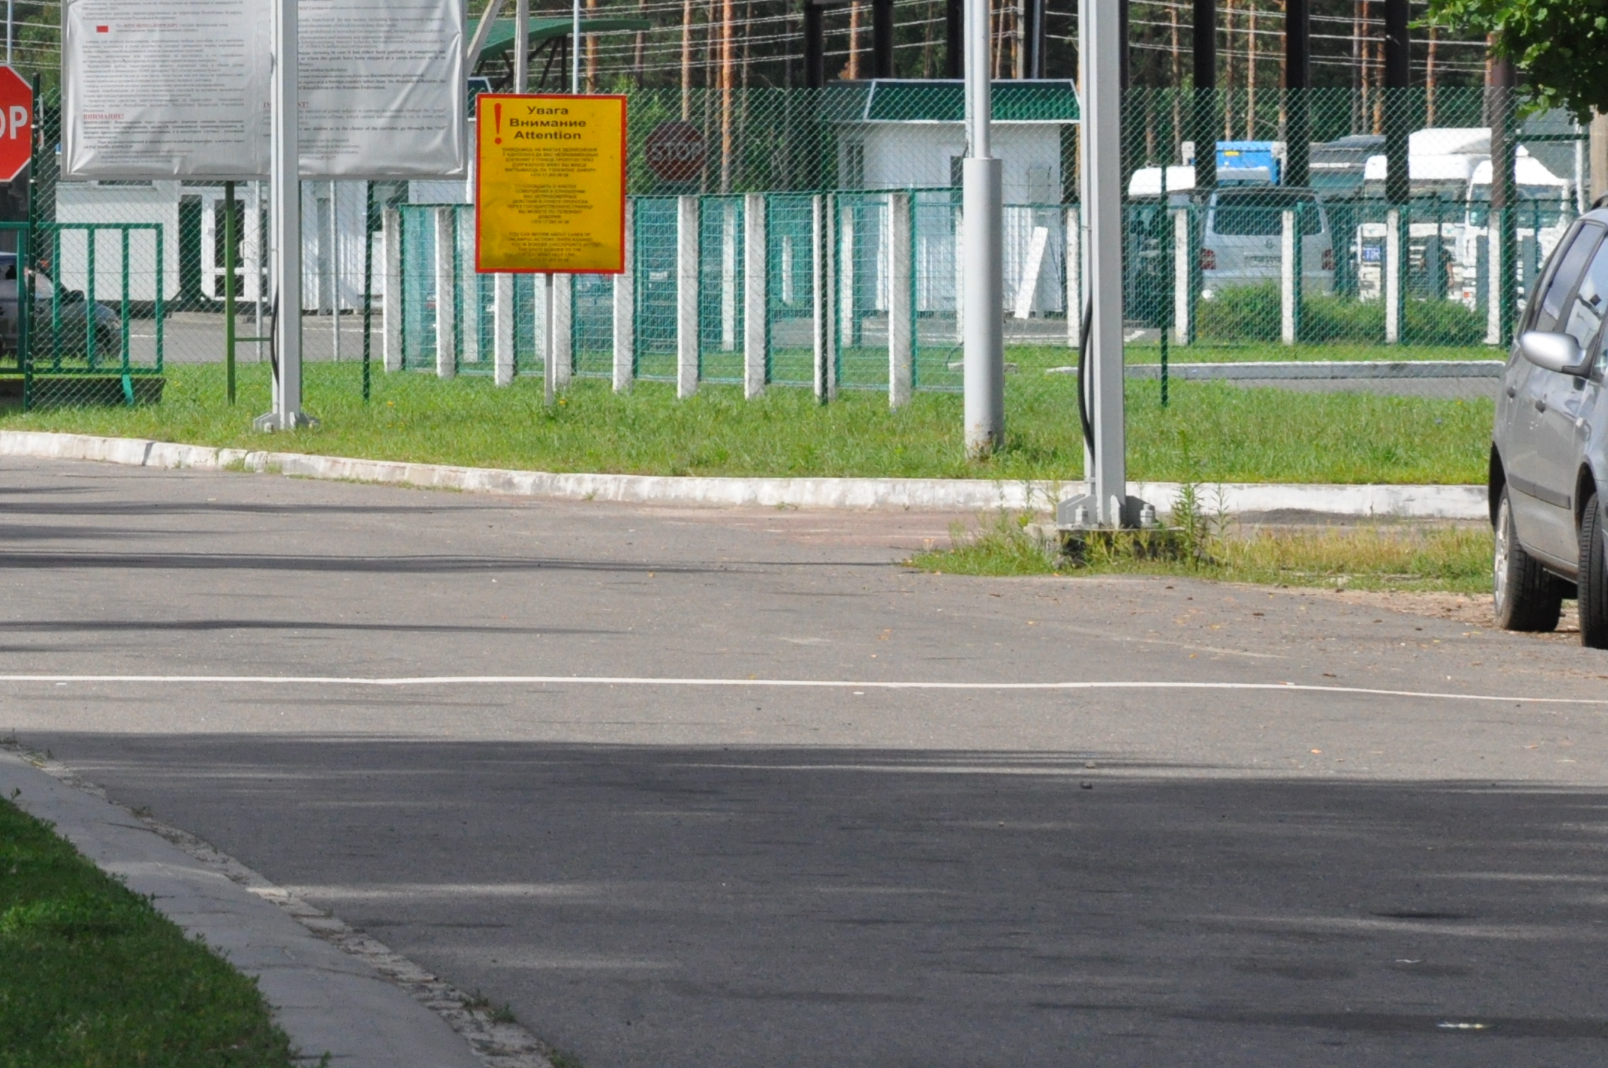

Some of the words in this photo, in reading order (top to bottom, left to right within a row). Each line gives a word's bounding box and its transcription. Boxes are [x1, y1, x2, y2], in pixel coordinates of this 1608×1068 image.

[526, 105, 569, 115] Увага
[509, 118, 587, 127] Внимание
[514, 131, 582, 139] Attention
[651, 141, 702, 161] STOP
